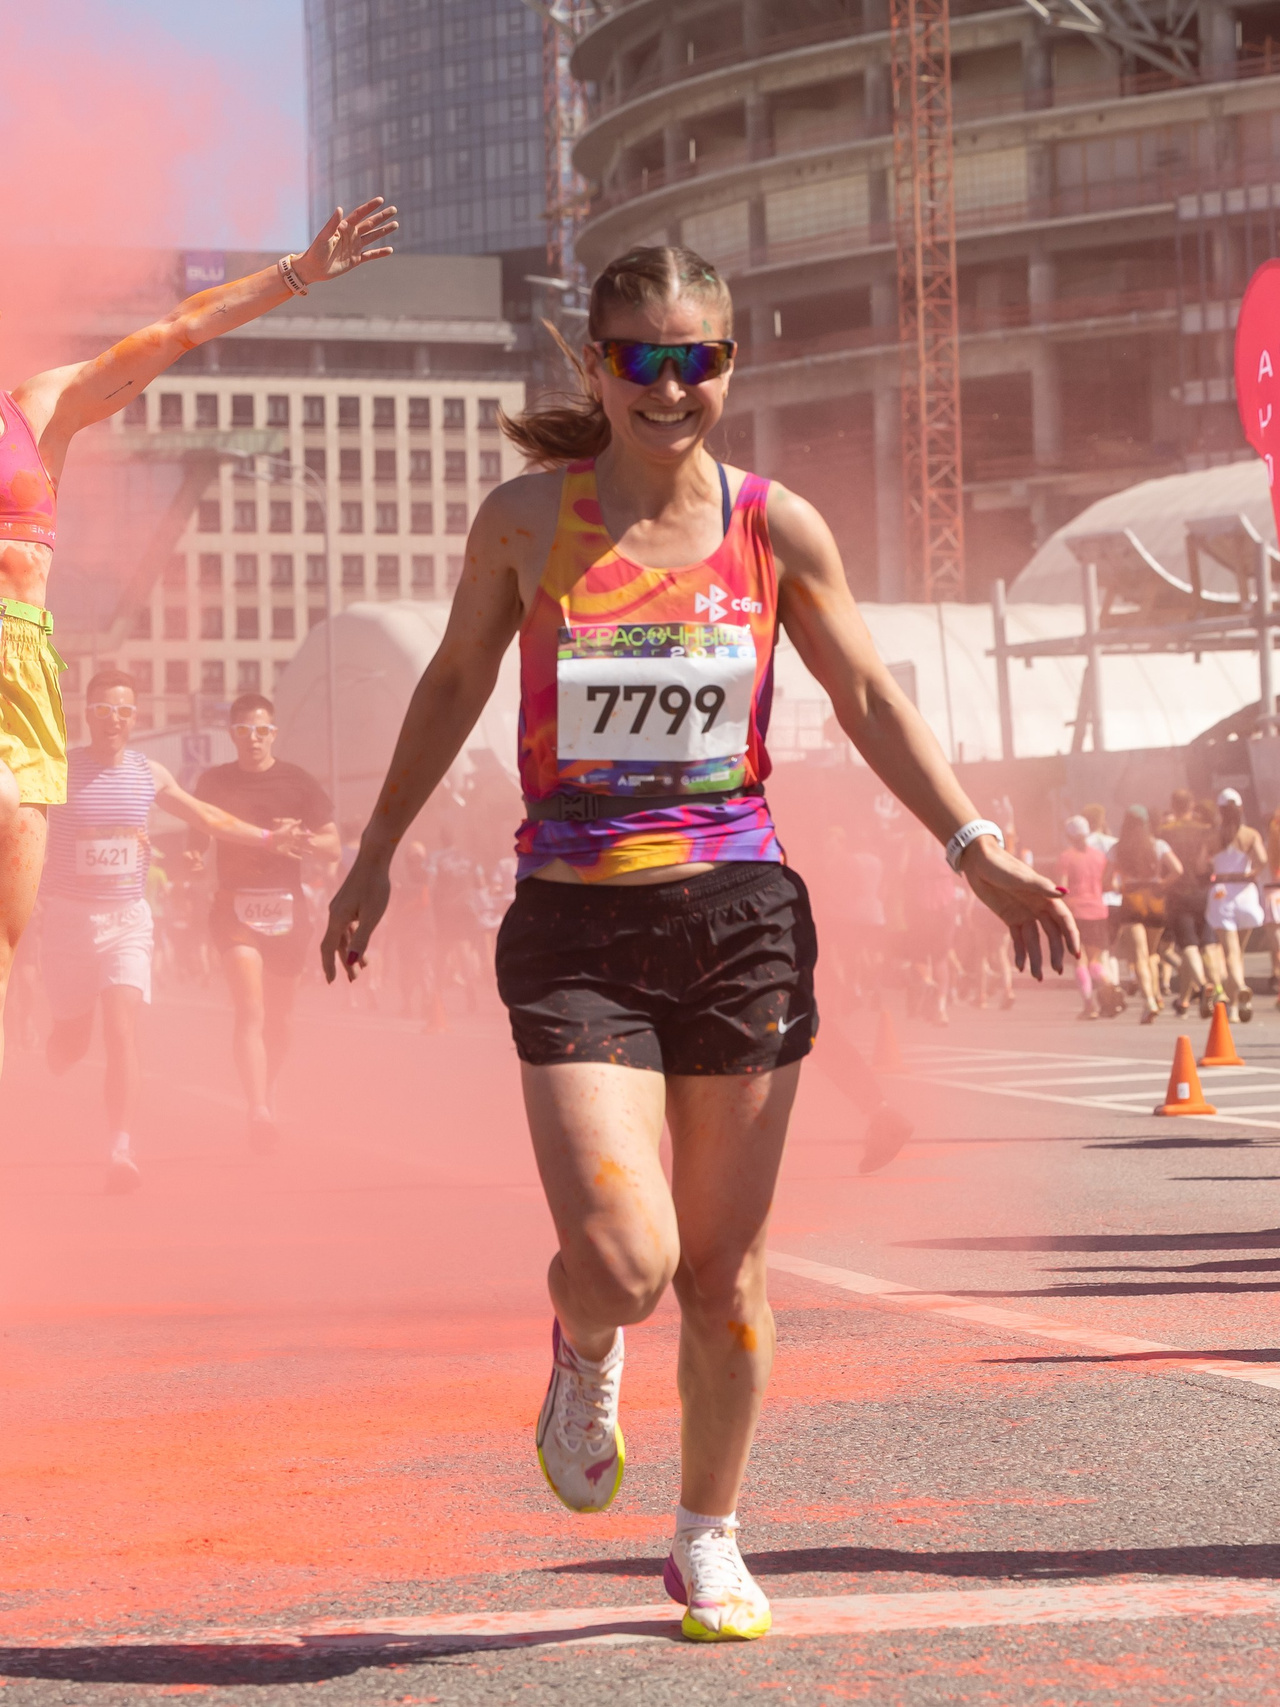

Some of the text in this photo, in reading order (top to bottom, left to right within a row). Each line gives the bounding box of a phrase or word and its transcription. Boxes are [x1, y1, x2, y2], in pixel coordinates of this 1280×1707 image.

[731, 597, 762, 614] сбп
[576, 625, 739, 648] КРАСОЧНЫЙ
[670, 645, 753, 659] 2026
[587, 684, 726, 735] 7799
[85, 848, 128, 867] 5421
[244, 902, 282, 918] 6164
